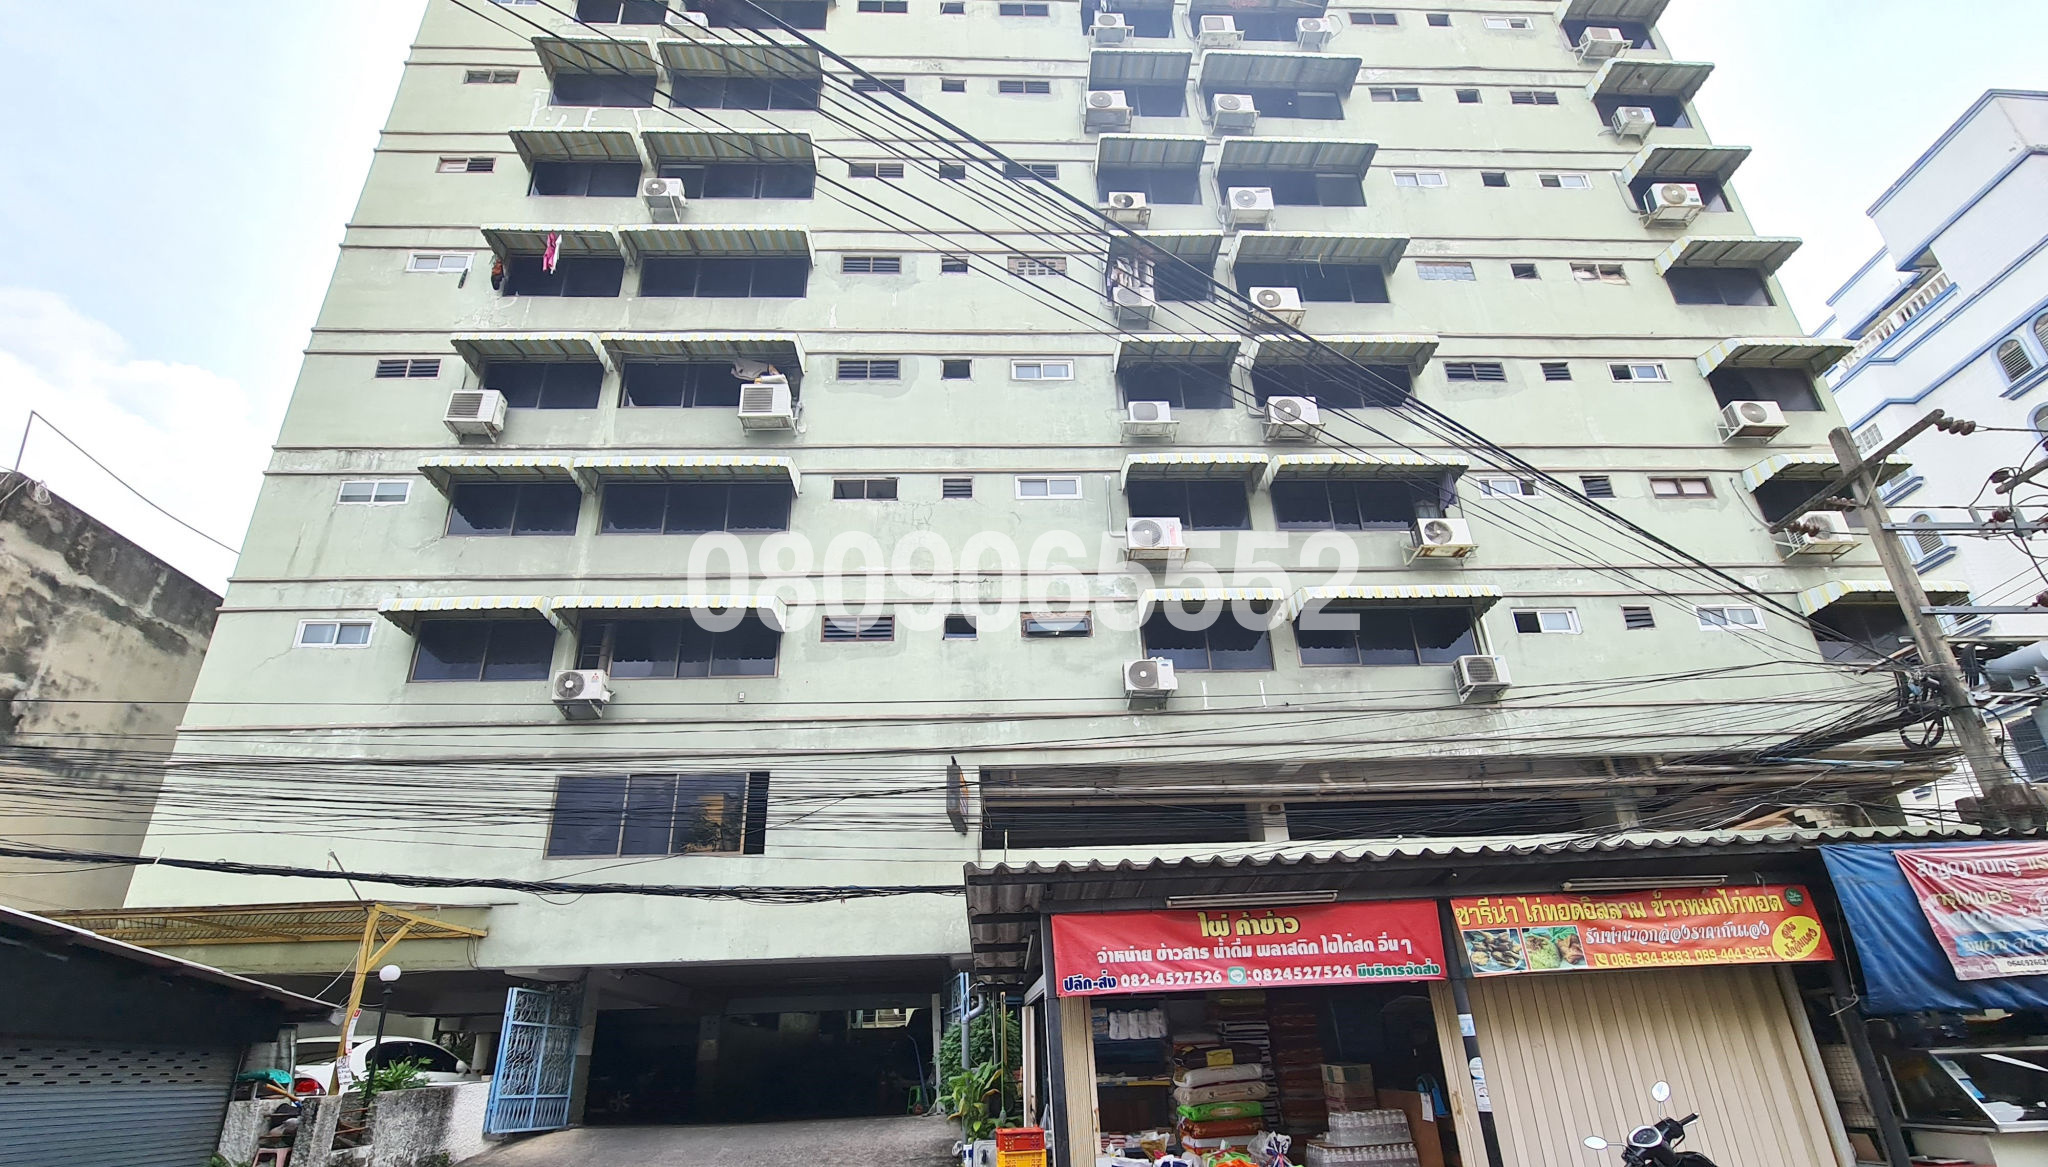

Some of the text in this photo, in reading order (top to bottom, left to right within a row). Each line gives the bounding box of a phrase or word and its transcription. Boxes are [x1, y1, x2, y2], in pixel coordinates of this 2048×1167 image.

[1456, 889, 1784, 926] ซารีน่า ไก่ทอดอิสลาม ข้าวหมกไก่ทอด
[1198, 910, 1299, 937] ไผ่ ค้าข้าว
[1097, 946, 1152, 963] จำหน่าย
[1158, 943, 1209, 961] ข้าวสาร
[1214, 938, 1252, 959] น้ำดื่ม
[1257, 939, 1318, 956] พลาสติก
[1064, 970, 1117, 991] ปลีก-ส่ง
[1121, 972, 1222, 987] 082-4527526
[1357, 958, 1440, 977] มีบริการจัดส่ง
